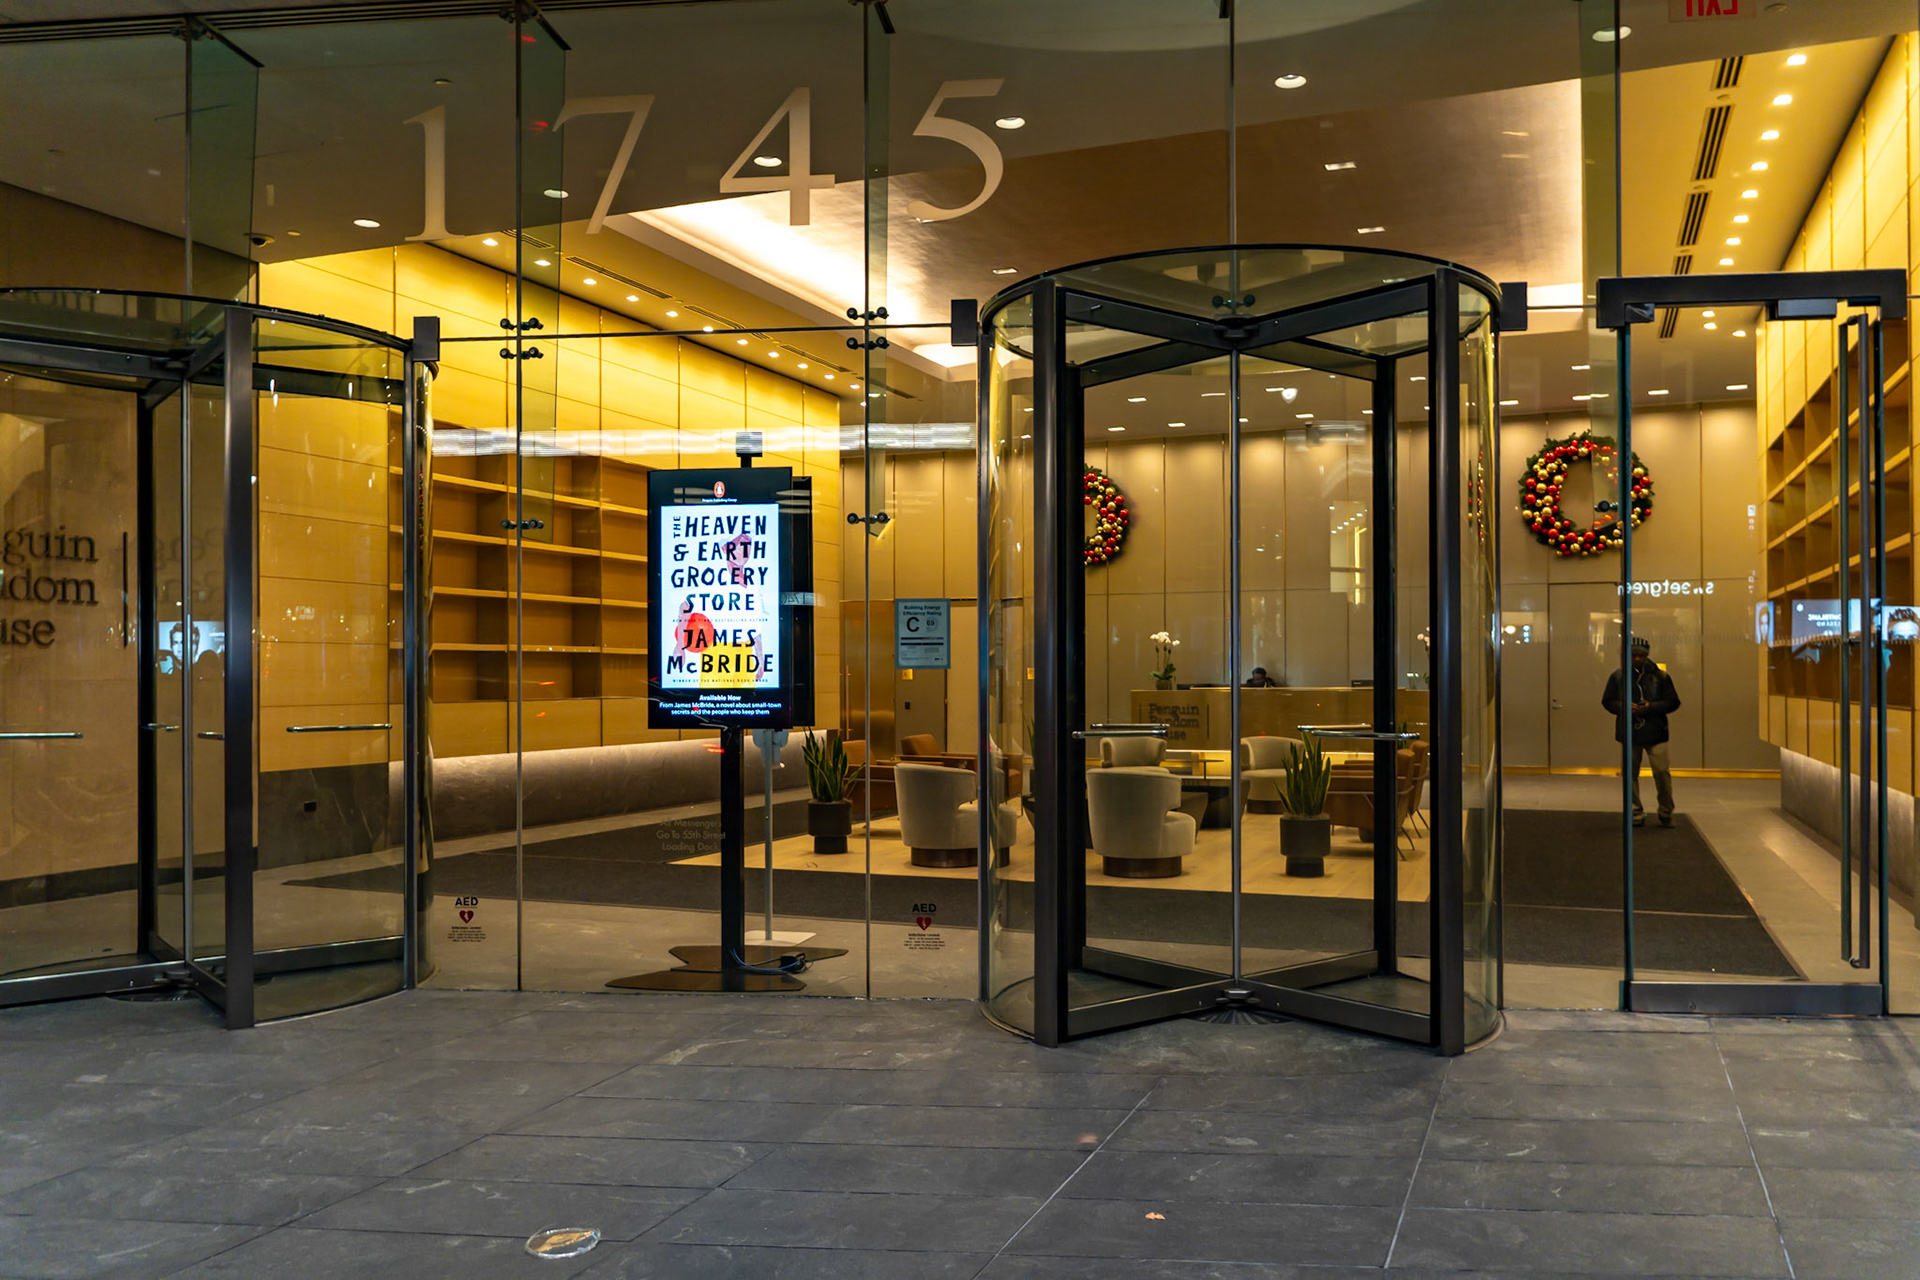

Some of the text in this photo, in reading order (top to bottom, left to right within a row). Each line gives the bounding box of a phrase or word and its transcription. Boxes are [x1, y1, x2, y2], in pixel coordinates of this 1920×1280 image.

[403, 78, 1005, 242] 1745
[673, 515, 681, 538] THE
[685, 515, 767, 537] HEAVEN
[673, 541, 767, 561] & EARTH
[0, 568, 99, 606] dom
[671, 566, 768, 588] GROCERY
[683, 593, 755, 613] STORE
[0, 619, 56, 647] se
[906, 616, 920, 633] C
[682, 629, 757, 650] JAMES
[667, 654, 773, 674] McBRIDE
[455, 896, 479, 906] AED
[911, 903, 937, 913] AED
